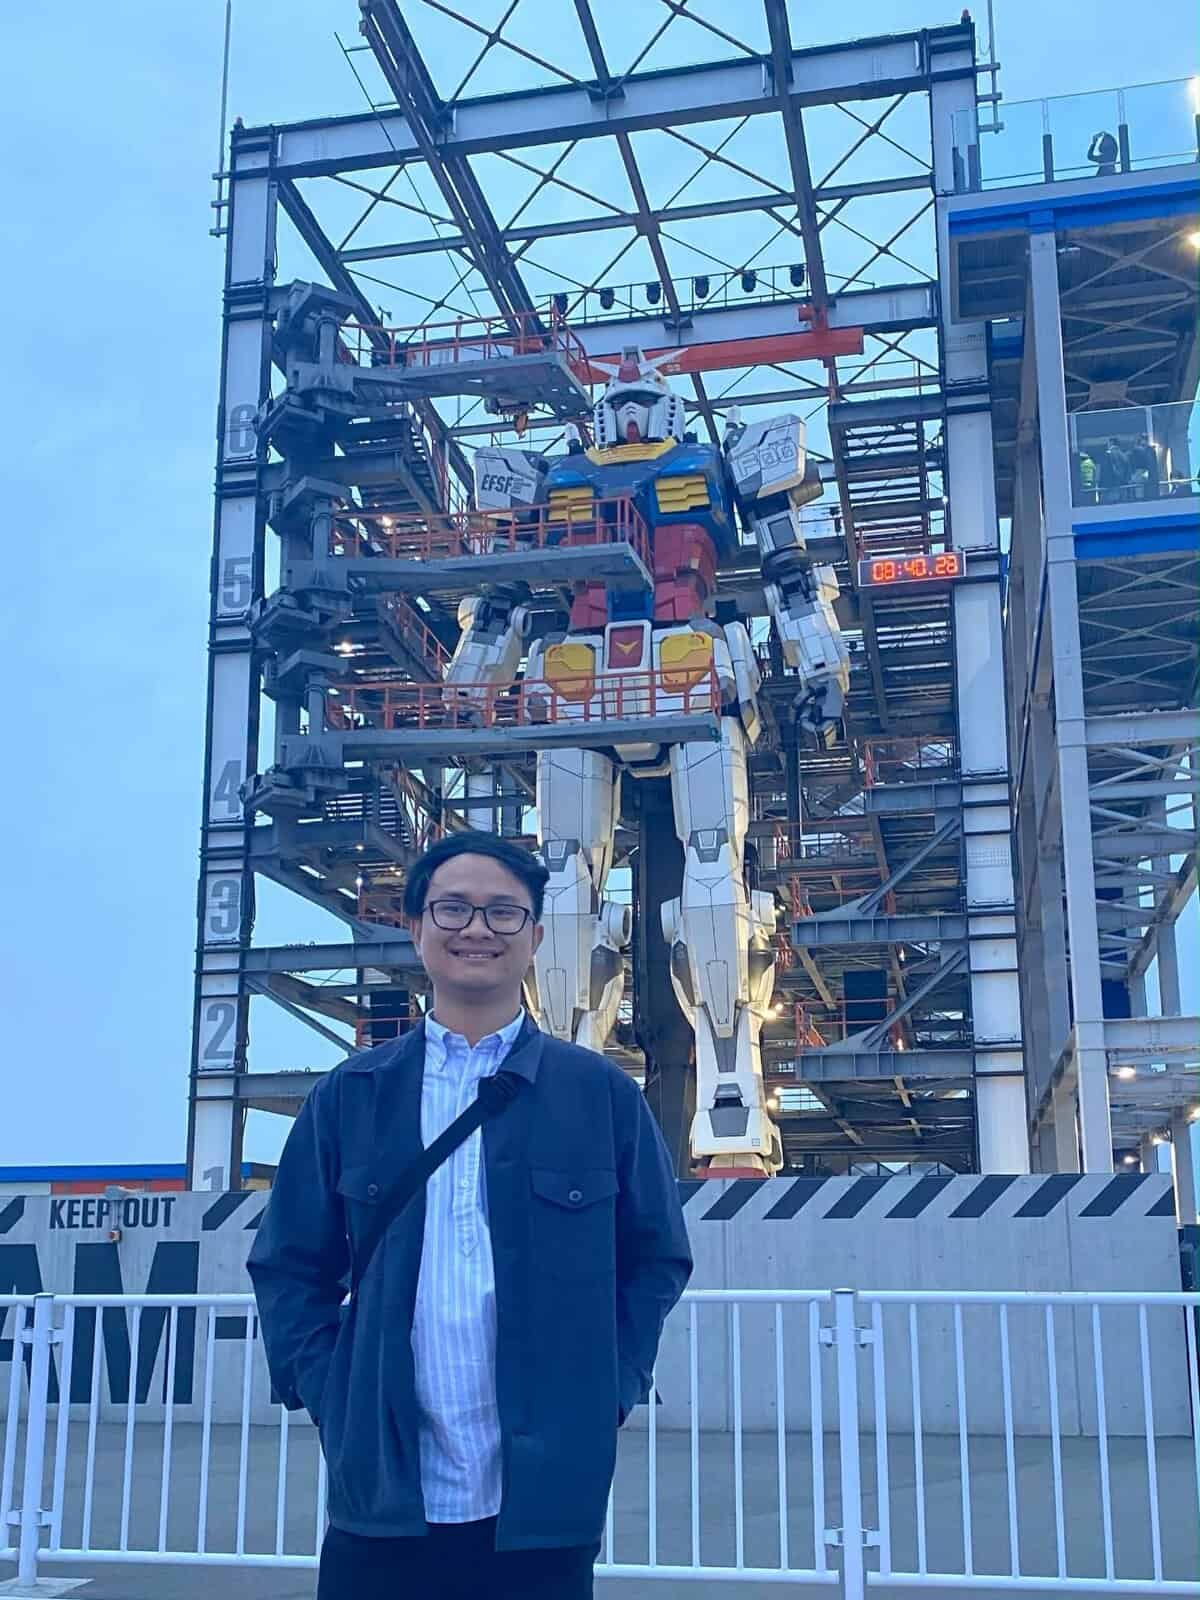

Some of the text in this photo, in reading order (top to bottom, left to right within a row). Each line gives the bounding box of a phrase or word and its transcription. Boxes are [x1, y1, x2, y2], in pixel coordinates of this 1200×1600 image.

[230, 404, 257, 453] 6
[481, 473, 513, 494] EFSF
[223, 556, 252, 608] 5
[214, 760, 241, 813] 4
[210, 879, 240, 934] 3
[204, 1002, 235, 1060] 2
[50, 1197, 176, 1229] KEEP OUT
